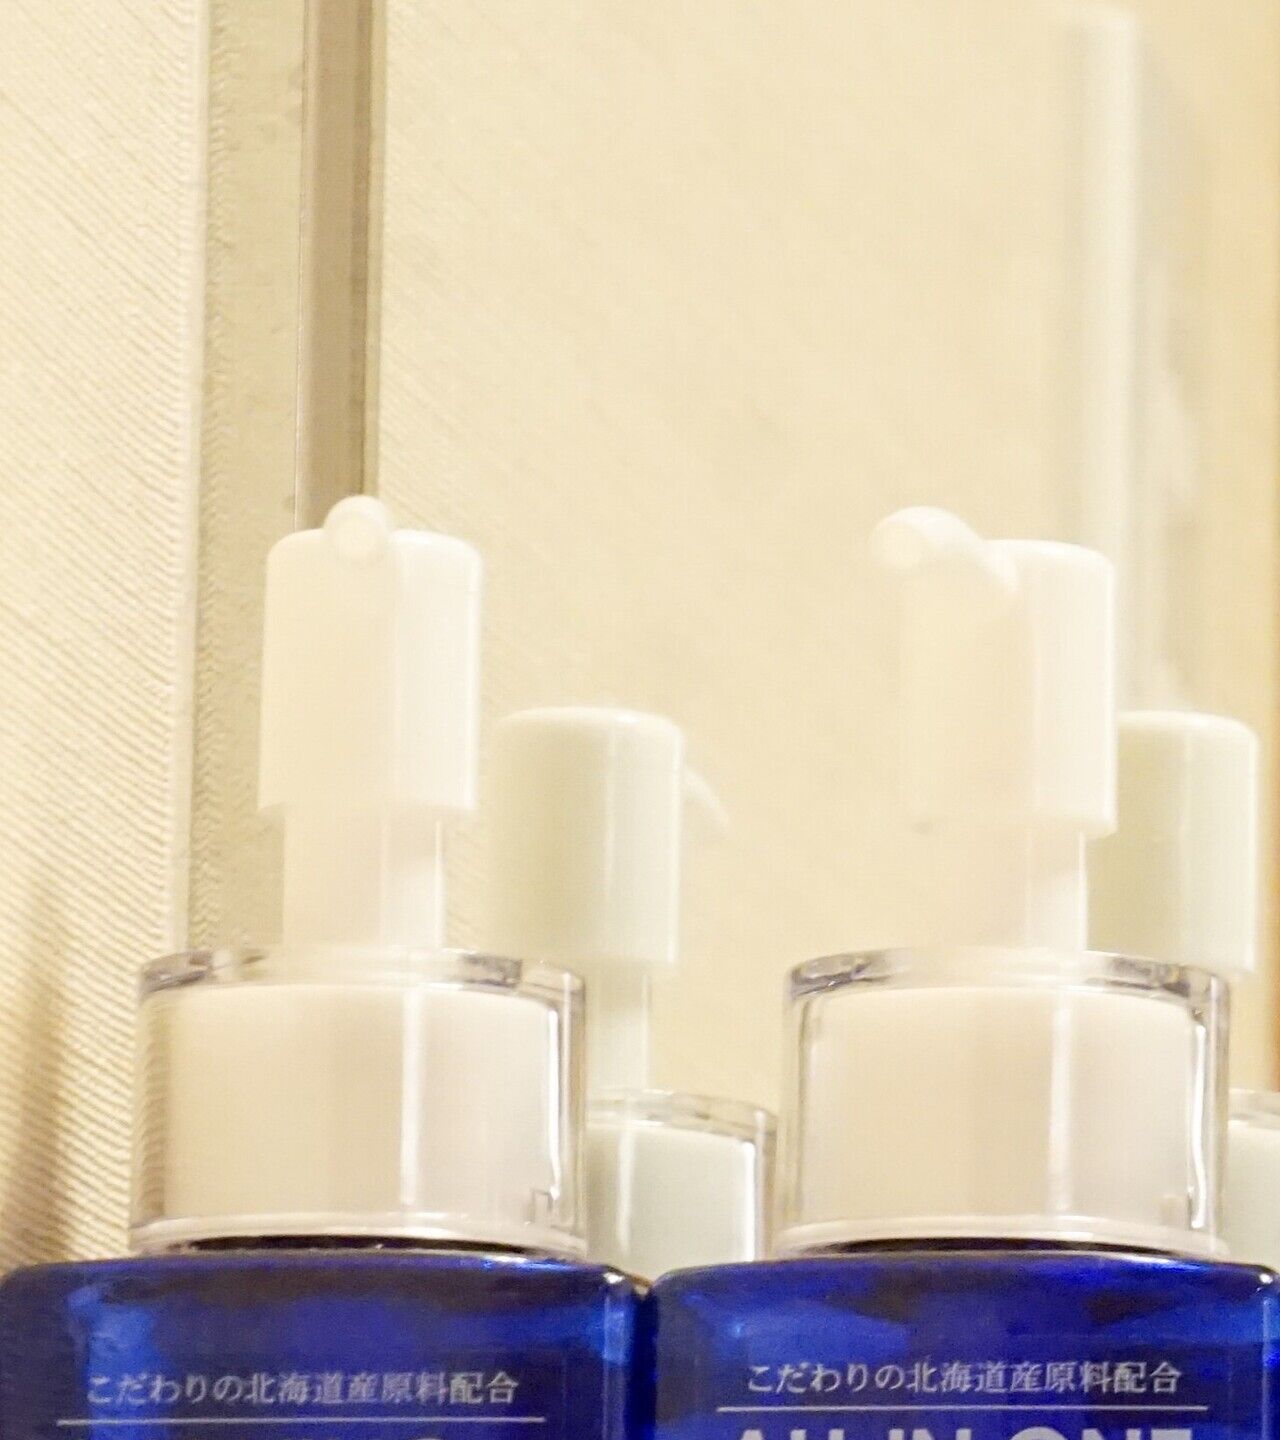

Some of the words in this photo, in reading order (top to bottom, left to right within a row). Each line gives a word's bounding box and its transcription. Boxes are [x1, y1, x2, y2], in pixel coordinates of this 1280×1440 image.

[87, 1370, 518, 1407] こだわりの北海道産原料配合
[747, 1359, 1181, 1394] こだわりの北海道産原料配合
